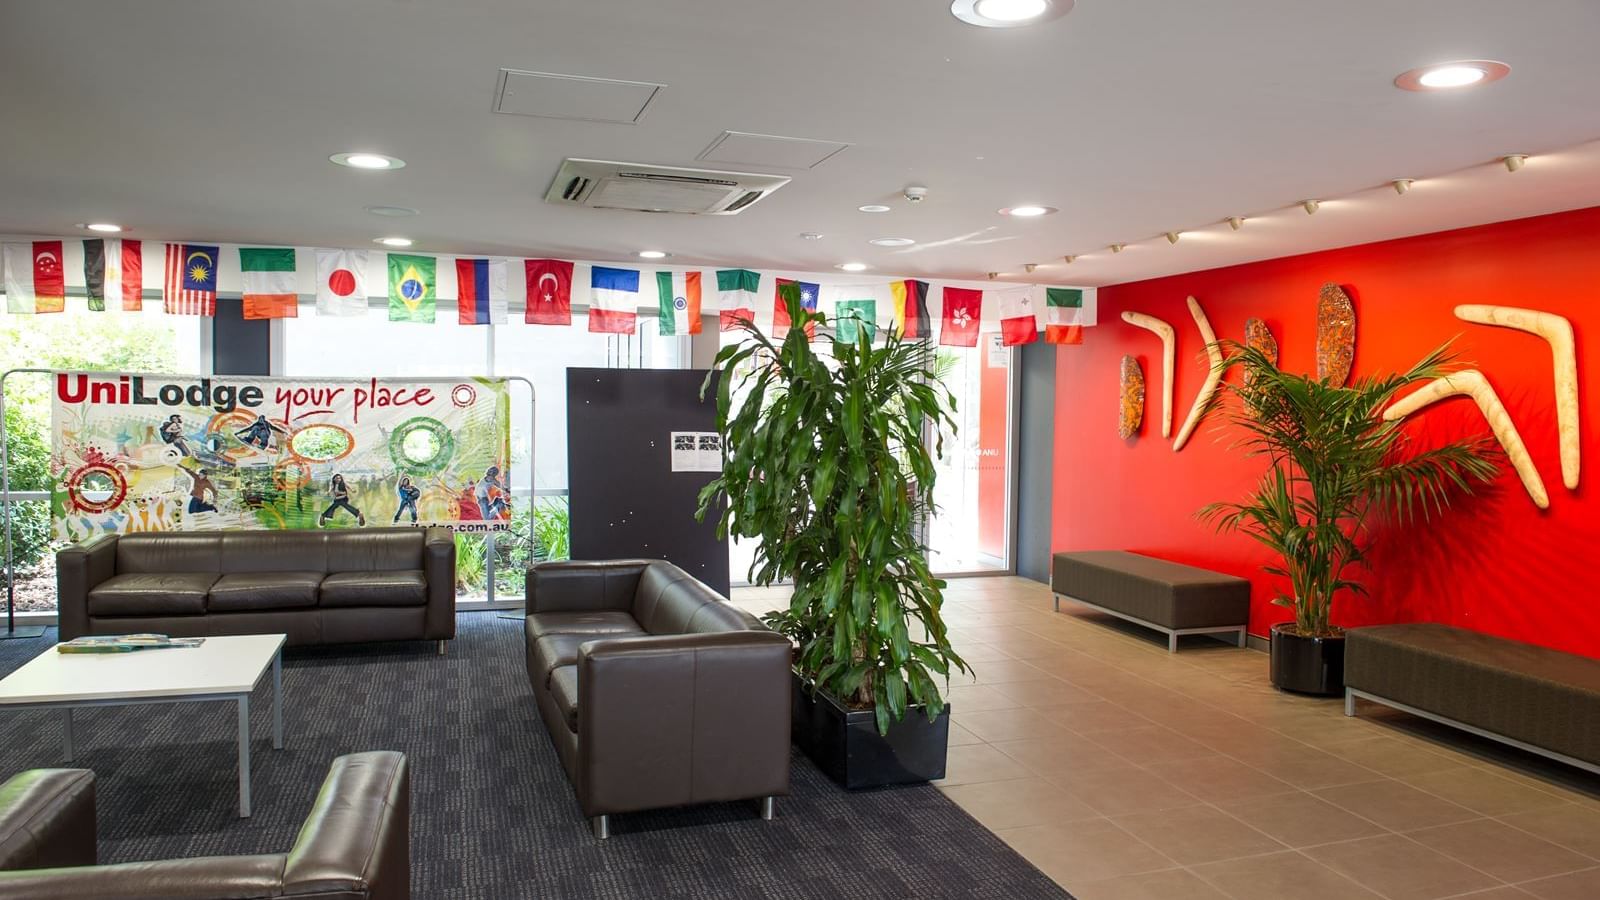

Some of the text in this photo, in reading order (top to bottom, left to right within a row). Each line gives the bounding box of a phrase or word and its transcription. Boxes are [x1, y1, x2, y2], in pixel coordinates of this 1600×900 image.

[57, 373, 435, 425] UniLodge your place
